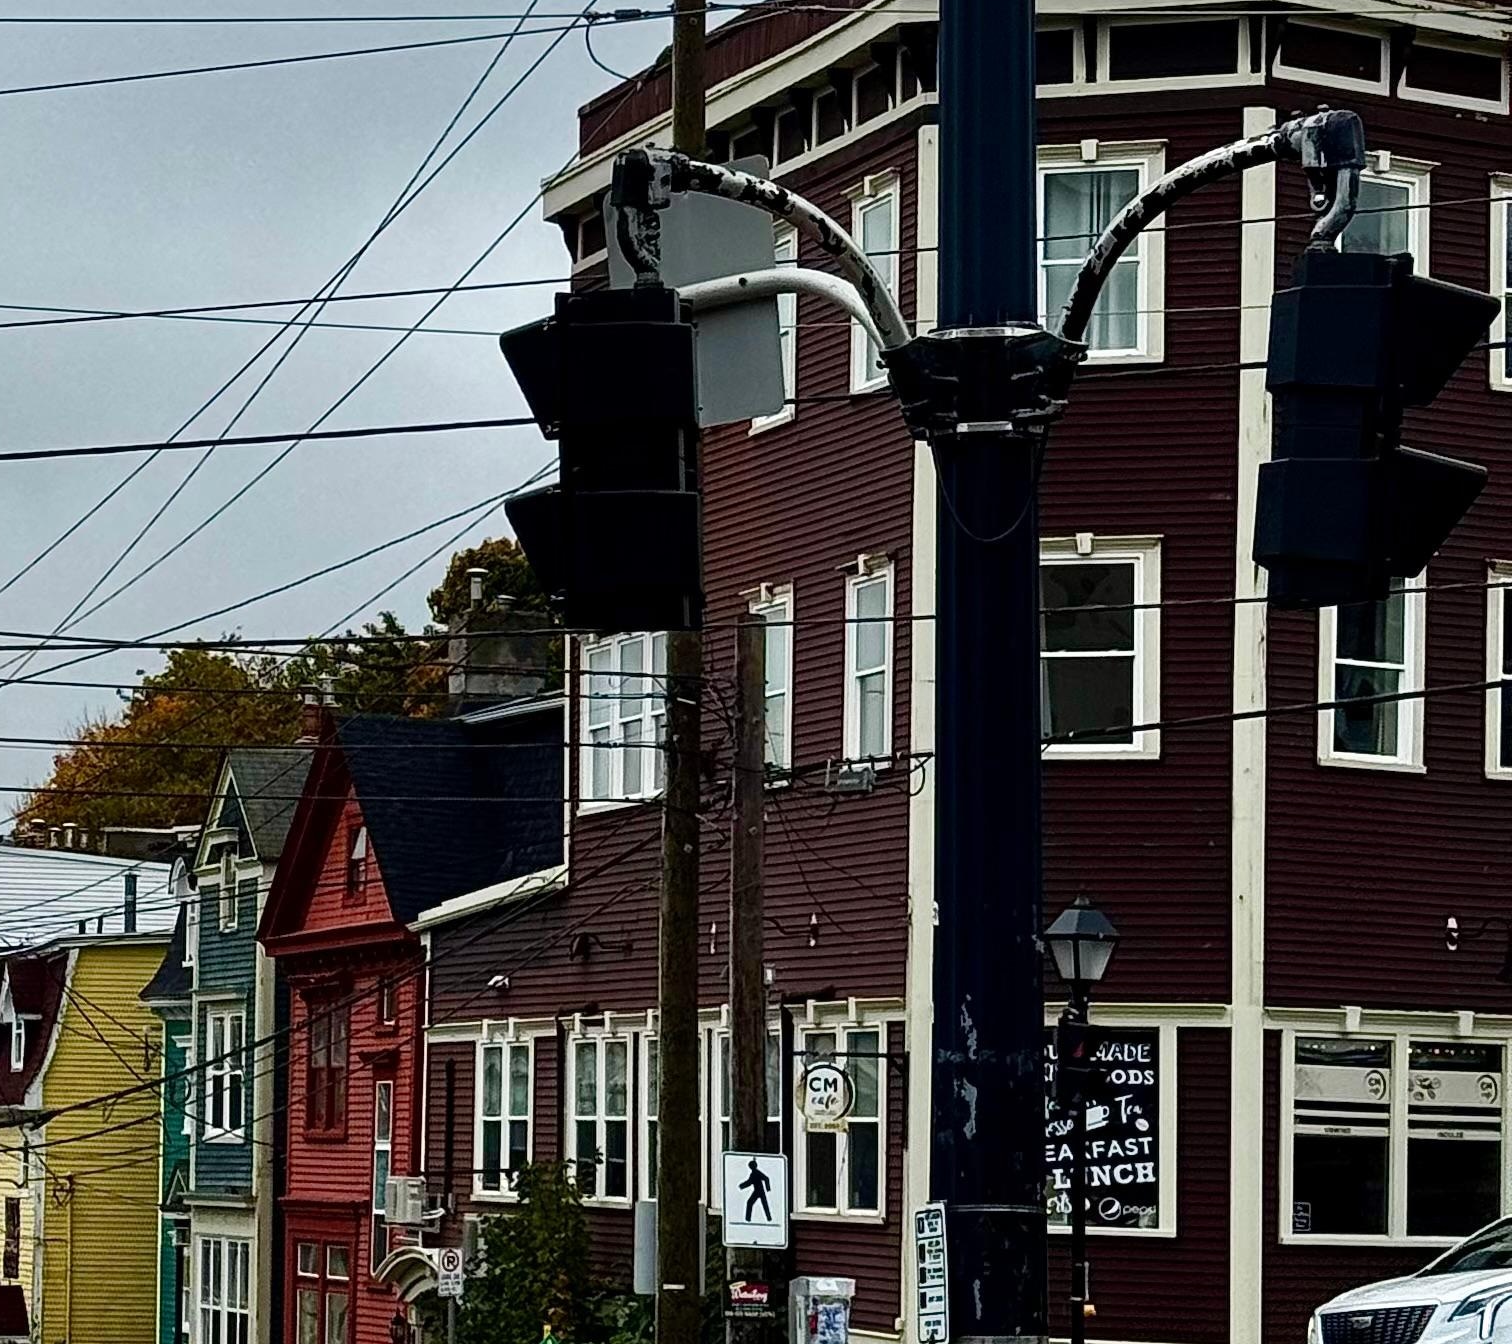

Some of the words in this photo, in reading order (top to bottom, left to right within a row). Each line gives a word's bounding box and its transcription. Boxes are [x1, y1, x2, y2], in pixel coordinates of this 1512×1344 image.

[809, 1077, 838, 1093] CM
[1045, 1136, 1153, 1162] EAFAST
[1052, 1161, 1157, 1189] LNCH
